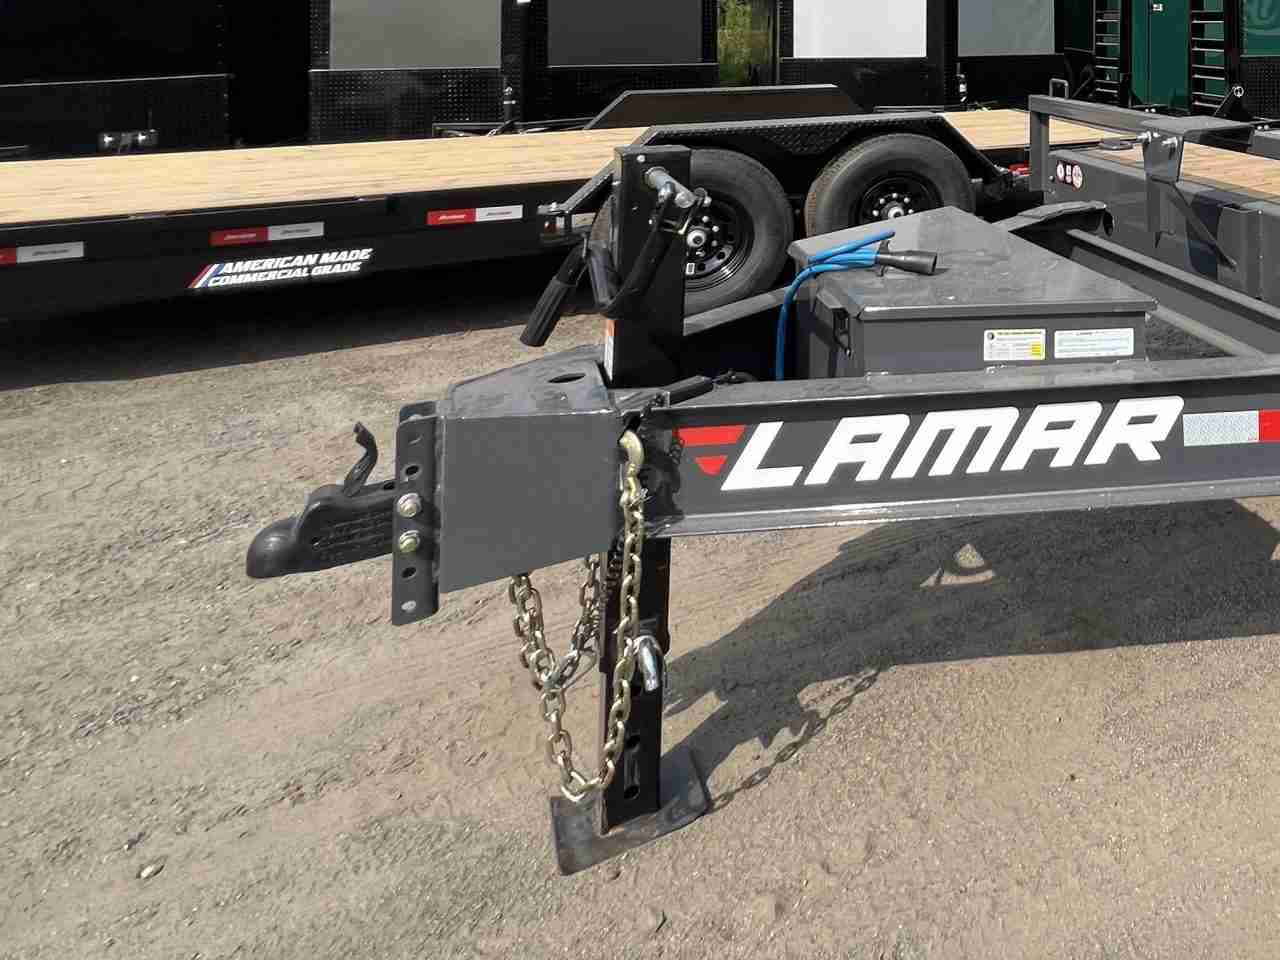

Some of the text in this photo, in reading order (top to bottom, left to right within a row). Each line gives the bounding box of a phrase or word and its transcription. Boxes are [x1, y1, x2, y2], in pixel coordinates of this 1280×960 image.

[222, 248, 373, 274] AMERICAN MADE
[207, 262, 363, 287] COMMERCIAL GRADE
[720, 395, 1185, 492] LAMAR
